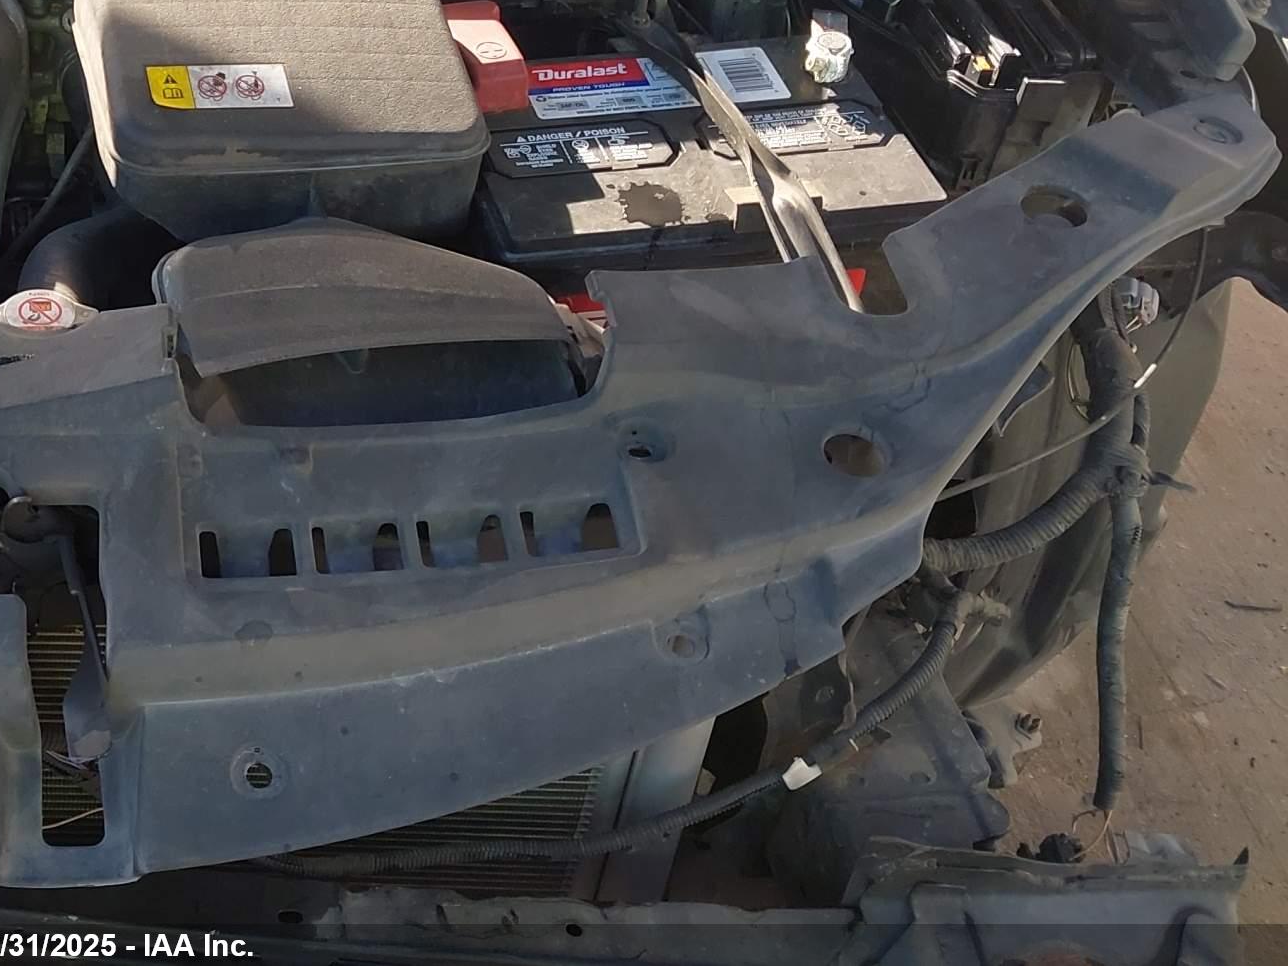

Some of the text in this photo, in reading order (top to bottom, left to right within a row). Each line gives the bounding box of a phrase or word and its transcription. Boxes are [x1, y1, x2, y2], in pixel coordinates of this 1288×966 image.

[532, 62, 628, 82] Duralast
[552, 85, 592, 93] PROVEN
[594, 82, 626, 90] TOUGH
[527, 131, 573, 142] DANGER
[584, 126, 625, 137] POISON
